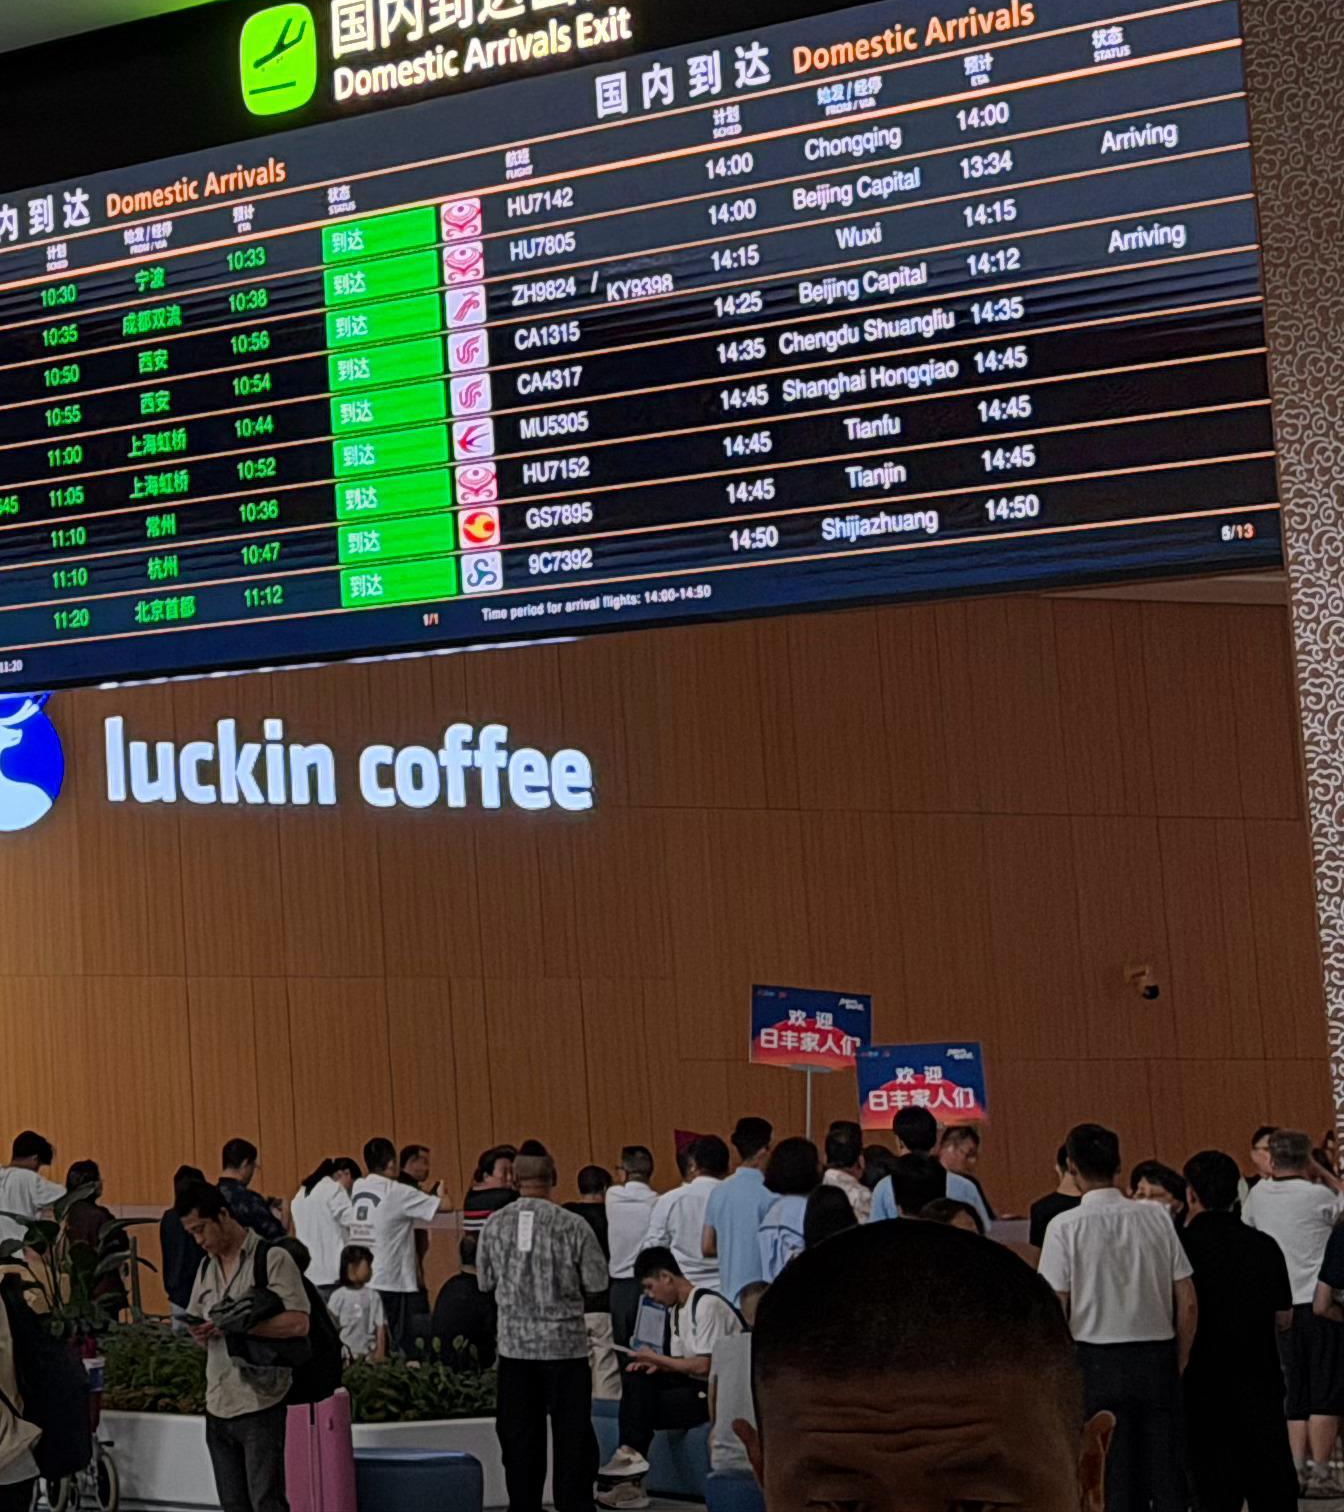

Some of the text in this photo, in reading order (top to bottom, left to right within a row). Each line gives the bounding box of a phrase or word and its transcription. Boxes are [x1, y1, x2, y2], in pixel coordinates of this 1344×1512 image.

[334, 6, 633, 102] Domestic Arrivals Exit
[793, 24, 918, 74] Domestic
[1093, 44, 1131, 63] STATUS
[595, 41, 771, 119] 国内到达
[956, 102, 1009, 130] 14:00
[805, 126, 902, 163] Chongqing
[1101, 123, 1178, 154] Arriving
[705, 152, 753, 179] 14:00
[960, 150, 1013, 179] 13:34
[106, 157, 286, 218] Domestic Arrivals
[793, 167, 920, 210] Beijing Capital
[507, 187, 573, 217] HU7142
[709, 198, 756, 225] 14:00
[963, 199, 1016, 227] 14:15
[332, 230, 364, 252] 到达
[510, 231, 576, 261] HU7805
[835, 222, 882, 249] Wuxi
[1108, 223, 1186, 253] Arriving
[227, 246, 267, 271] 10:33
[711, 244, 759, 271] 14:15
[967, 247, 1020, 276] 14:12
[40, 283, 77, 307] 10:30
[334, 271, 365, 294] 到达
[512, 277, 576, 306] ZH9824
[799, 262, 927, 304] Beijing Capital
[229, 288, 269, 312] 10:38
[714, 291, 762, 317] 14:25
[971, 296, 1024, 324] 14:35
[43, 323, 79, 346] 10:35
[336, 316, 367, 337] 到达
[515, 321, 580, 350] CA1315
[779, 308, 955, 354] Chengdu Shuangliu
[230, 330, 271, 353] 10:56
[717, 338, 766, 363] 14:35
[137, 348, 169, 373] 西安
[338, 358, 370, 380] 到达
[974, 346, 1027, 373] 14:45
[43, 364, 81, 386] 10:50
[233, 373, 272, 395] 10:54
[517, 366, 582, 394] CA4317
[783, 359, 959, 401] Shanghai Hongqiao
[140, 389, 171, 414] 西安
[721, 384, 768, 410] 14:45
[978, 395, 1031, 422] 14:45
[46, 404, 82, 426] 10:55
[340, 401, 373, 424] 到达
[520, 411, 589, 439] MU5305
[235, 415, 275, 437] 10:44
[844, 414, 900, 440] Tianfu
[47, 445, 83, 466] 11:00
[127, 428, 187, 457] 上海虹桥
[344, 444, 374, 466] 到达
[723, 431, 772, 456] 14:45
[237, 456, 277, 479] 10:52
[523, 456, 590, 484] HU7152
[982, 444, 1035, 471] 14:45
[129, 469, 190, 498] 上海虹桥
[845, 462, 906, 489] Tianjin
[49, 486, 85, 506] 11:05
[346, 487, 377, 510] 到达
[727, 478, 775, 503] 14:45
[240, 499, 279, 522] 10:36
[526, 502, 593, 529] GS7895
[985, 494, 1039, 520] 14:50
[50, 526, 87, 547] 11:10
[145, 513, 177, 537] 常州
[730, 526, 778, 550] 14:50
[822, 511, 938, 542] Shijiazhuang
[241, 541, 281, 565] 10:47
[349, 530, 380, 553] 到达
[147, 554, 179, 580] 杭州
[528, 548, 593, 574] 9C7392
[52, 567, 89, 588] 11:10
[350, 574, 382, 597] 到达
[244, 584, 284, 607] 11:12
[482, 608, 507, 620] Time
[510, 603, 544, 620] period
[547, 602, 562, 614] for
[565, 597, 600, 612] arrival
[603, 594, 641, 610] flights:
[53, 608, 91, 629] 11:20
[134, 595, 197, 623] 北京首都
[104, 716, 594, 810] luckin coffee
[788, 1009, 834, 1030] 欢迎
[760, 1028, 861, 1056] 日丰家人们
[895, 1065, 943, 1084] 欢迎
